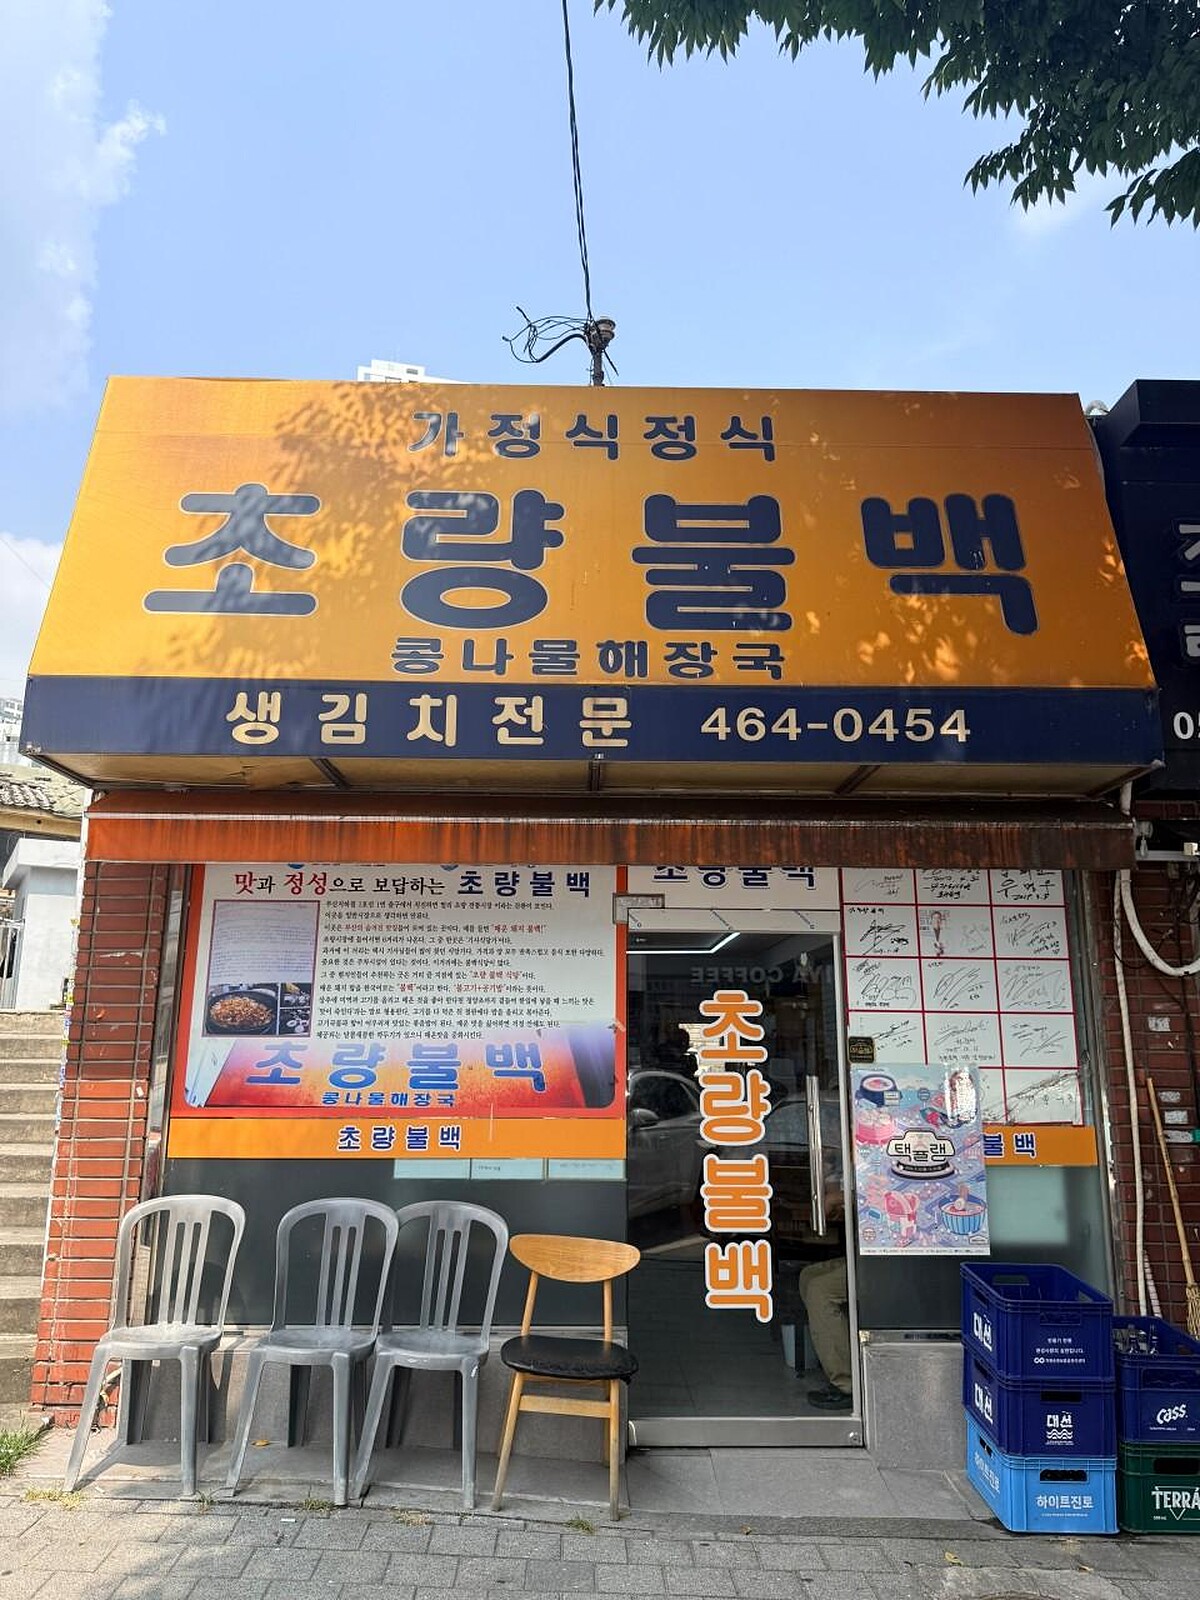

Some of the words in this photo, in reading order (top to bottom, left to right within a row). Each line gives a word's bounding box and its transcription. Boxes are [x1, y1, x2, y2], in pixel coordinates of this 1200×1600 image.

[143, 482, 1038, 637] 초량불백
[391, 637, 785, 681] 콩나물해장국
[225, 691, 632, 748] 생김치전문
[700, 706, 970, 744] 464-0454
[1172, 711, 1200, 740] 0
[234, 870, 276, 895] 맛과
[283, 871, 366, 896] 정성으로
[373, 873, 446, 897] 보답하는
[457, 870, 591, 898] 초량불백
[246, 1040, 547, 1093] 초량불백
[321, 1091, 456, 1107] 콩나물해장국
[338, 1125, 462, 1151] 초량불백
[700, 990, 774, 1323] 초량불백
[973, 1312, 993, 1352] 대선
[974, 1382, 994, 1425] 대선
[1046, 1410, 1074, 1428] 대선
[1034, 1494, 1095, 1510] 하이트진로
